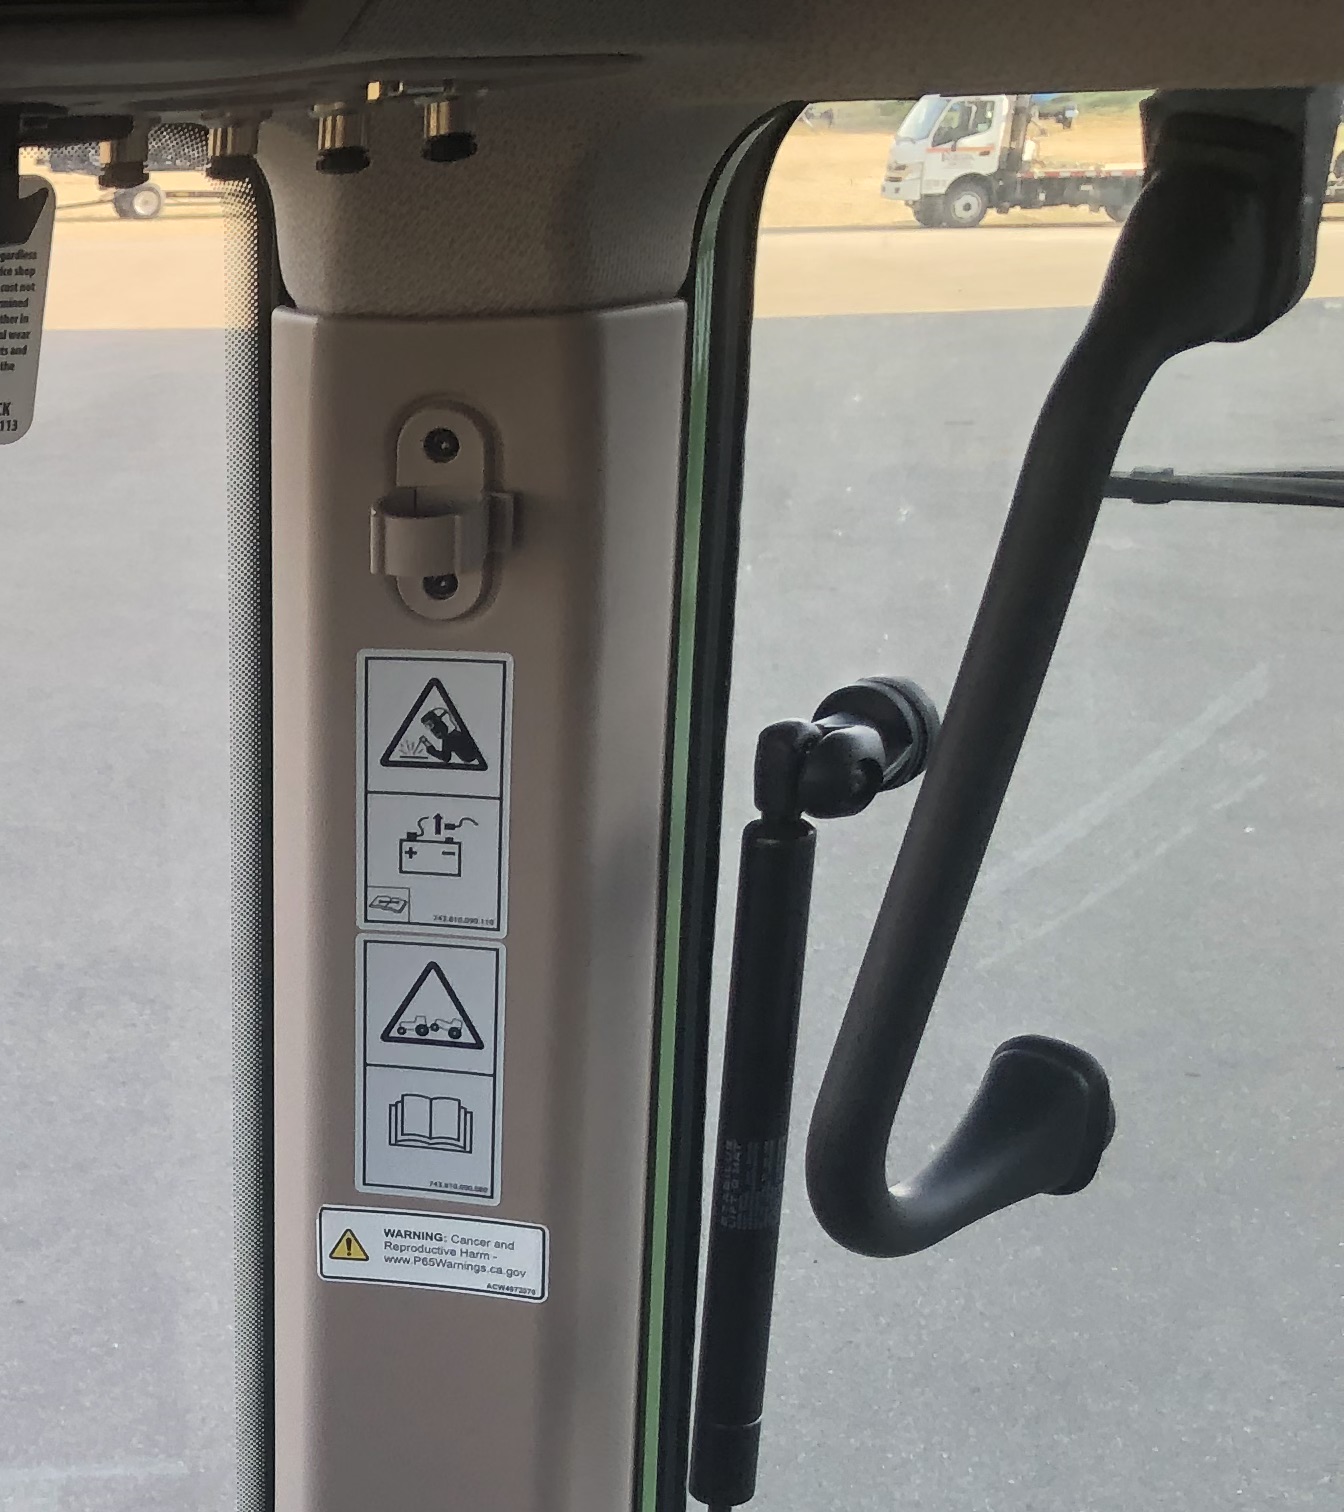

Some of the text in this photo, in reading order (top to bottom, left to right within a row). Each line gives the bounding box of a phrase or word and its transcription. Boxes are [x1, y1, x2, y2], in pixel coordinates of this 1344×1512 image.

[384, 1229, 515, 1250] WARNING: Cancer and
[384, 1242, 456, 1256] Reproductive
[460, 1250, 490, 1260] Harm
[384, 1255, 526, 1278] www.P65Warnings.ca.gov
